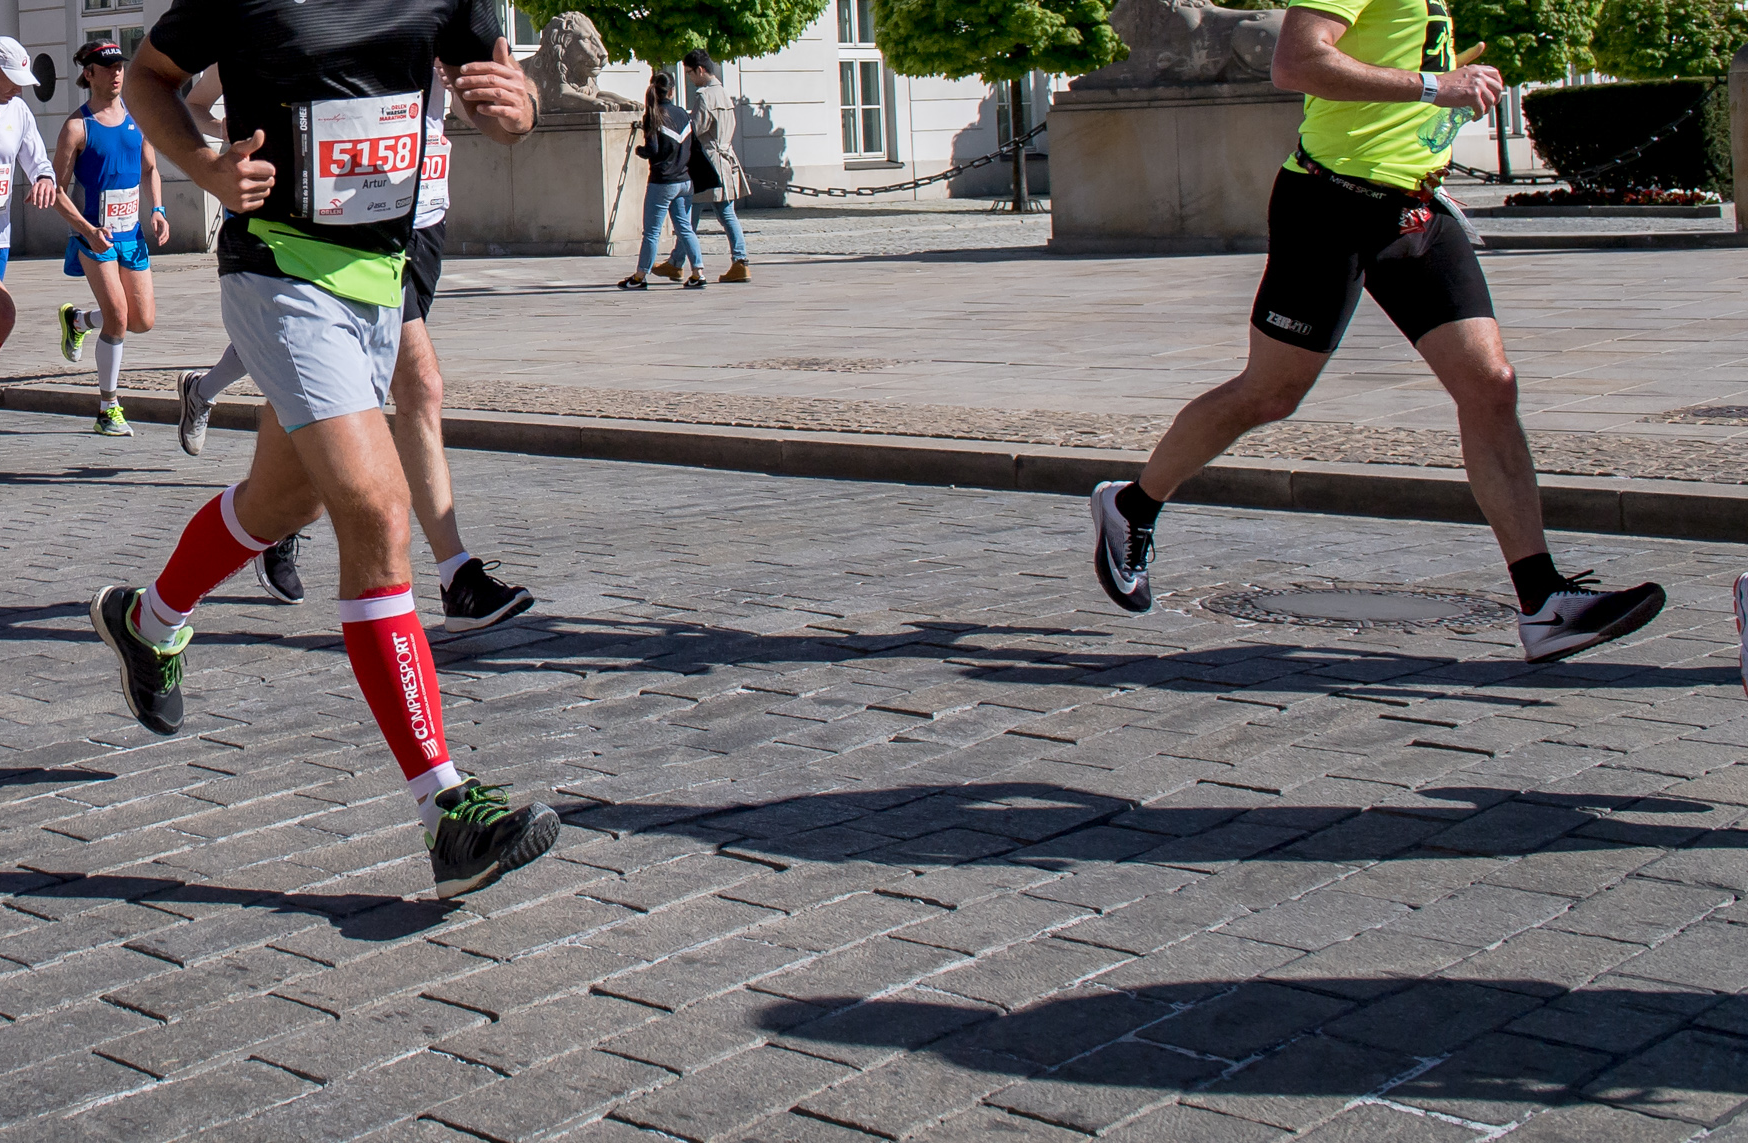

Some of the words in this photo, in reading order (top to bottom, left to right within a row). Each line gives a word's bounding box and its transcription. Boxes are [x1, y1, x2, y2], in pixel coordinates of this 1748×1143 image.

[299, 106, 308, 131] OSHEE
[330, 136, 412, 175] 5158
[362, 178, 387, 190] Artur
[110, 202, 138, 216] 3286
